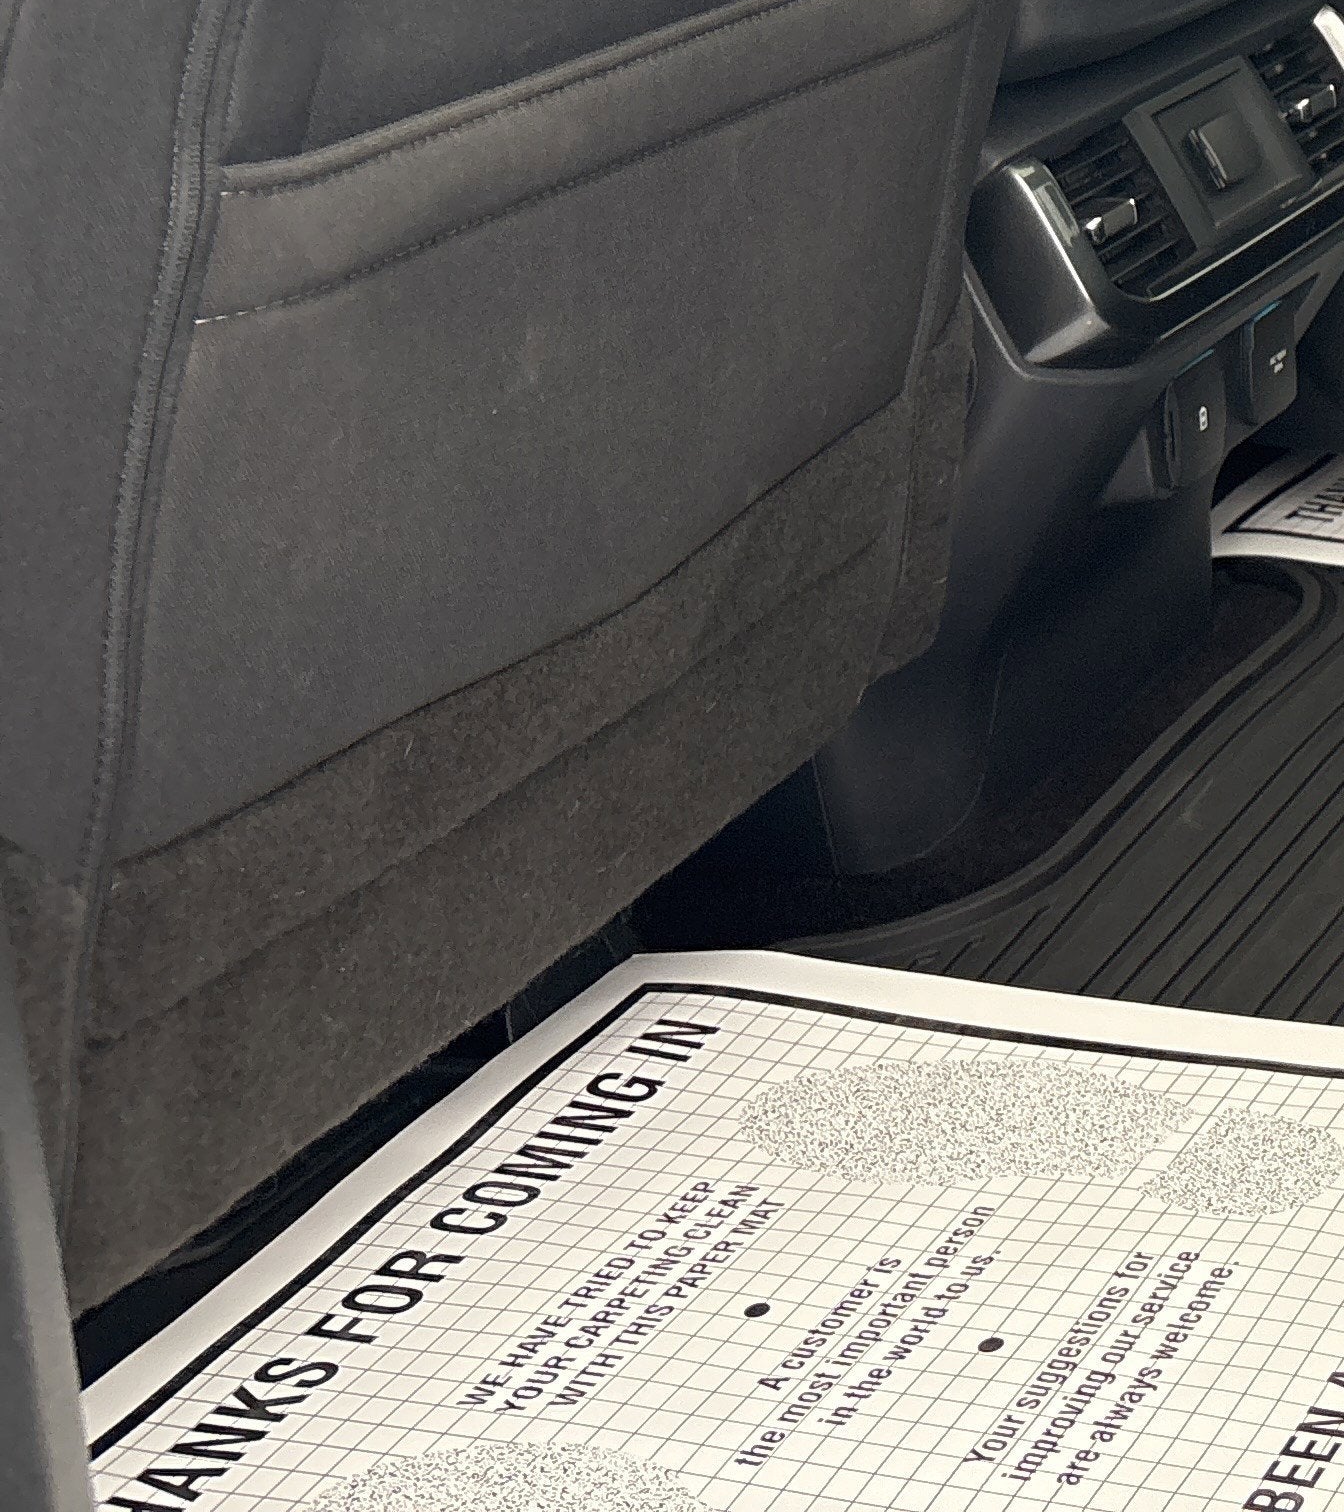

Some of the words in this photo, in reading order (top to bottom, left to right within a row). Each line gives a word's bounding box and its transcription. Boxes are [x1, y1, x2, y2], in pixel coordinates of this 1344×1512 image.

[303, 1249, 467, 1344] FOR
[429, 1072, 666, 1236] COMING
[626, 1018, 721, 1063] IN
[456, 1372, 513, 1407] WE
[500, 1314, 573, 1369] HAVE
[557, 1256, 636, 1310] TRIED
[627, 1229, 668, 1251] TO
[656, 1181, 716, 1225] KEEP
[496, 1354, 578, 1413] YOUR
[564, 1244, 693, 1350] CARPETING
[683, 1184, 761, 1240] CLEAN
[550, 1352, 624, 1407] WITH
[608, 1303, 675, 1347] THIS
[662, 1240, 744, 1299] PAPER
[731, 1197, 786, 1236] MAT
[734, 1430, 786, 1467] the
[777, 1372, 842, 1423] most
[824, 1271, 935, 1367] important
[923, 1205, 996, 1269] person
[757, 1376, 791, 1392] A
[781, 1278, 881, 1370] customer
[865, 1256, 902, 1274] is
[816, 1405, 859, 1426] in
[842, 1367, 893, 1400] the
[882, 1306, 949, 1361] world
[933, 1281, 970, 1301] to
[960, 1249, 1002, 1277] us.
[963, 1414, 1026, 1463] Your
[1015, 1285, 1130, 1410] suggestions
[1112, 1251, 1155, 1280] for
[1001, 1369, 1117, 1482] improving
[1101, 1329, 1142, 1365] our
[1131, 1250, 1202, 1326] service
[1056, 1448, 1101, 1486] are
[1090, 1366, 1163, 1443] always
[1149, 1260, 1240, 1361] welcome.
